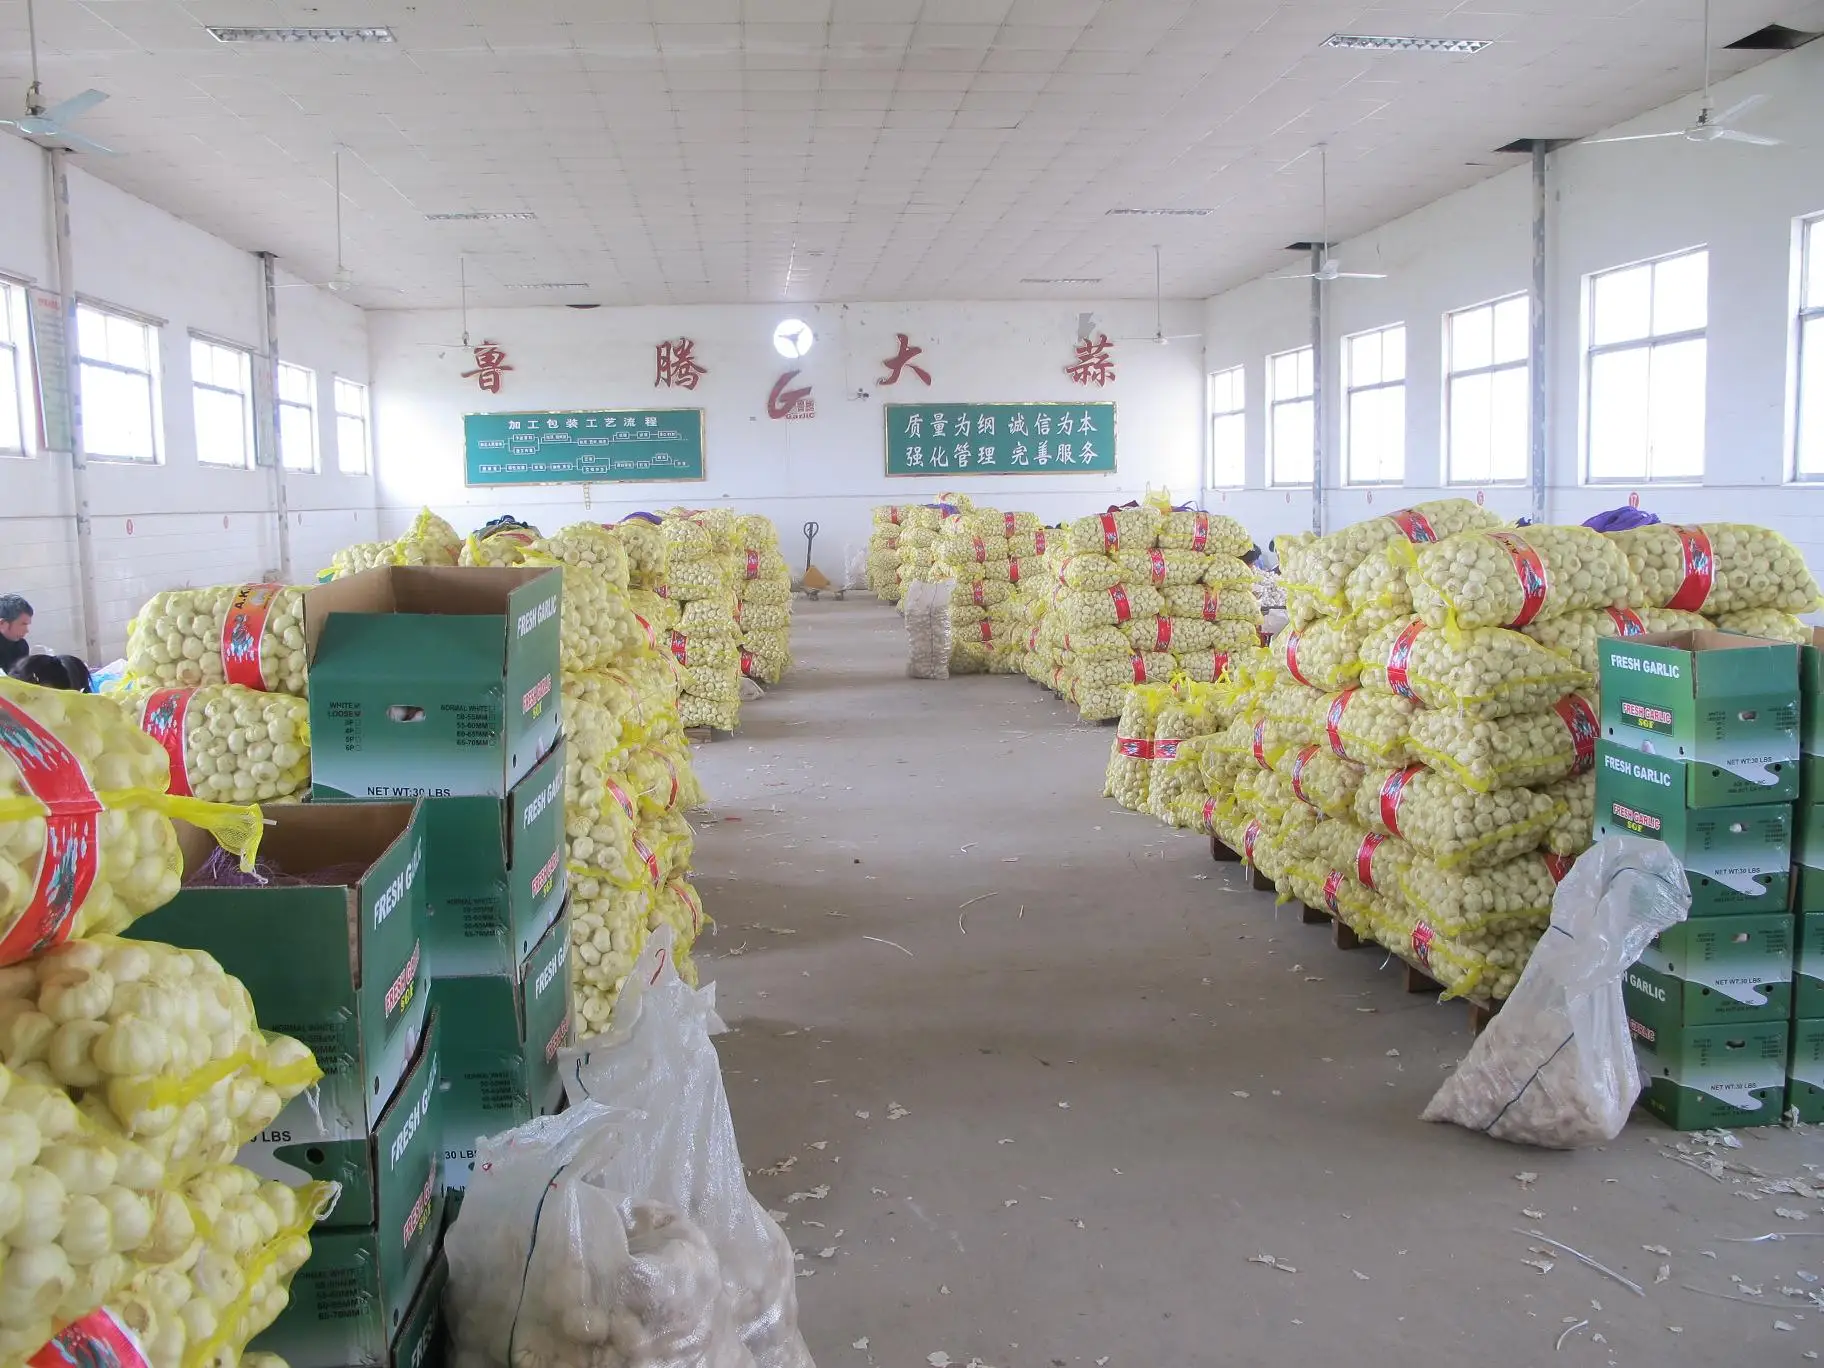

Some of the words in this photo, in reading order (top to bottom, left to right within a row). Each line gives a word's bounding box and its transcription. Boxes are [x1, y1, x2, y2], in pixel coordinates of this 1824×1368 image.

[461, 340, 513, 393] 鲁
[877, 333, 931, 386] 大
[1065, 334, 1116, 387] 蒜
[508, 417, 659, 430] 加工包装工艺流程
[905, 412, 995, 438] 质量为纲
[1008, 410, 1098, 436] 诚信为本
[905, 442, 996, 468] 强化管理
[1010, 440, 1098, 466] 完善服务
[516, 607, 537, 640] FRESH
[537, 594, 557, 625] GARLIC
[1610, 654, 1640, 671] FRESH
[1642, 660, 1680, 679] GARLIC
[1622, 702, 1645, 718] FRESH
[1645, 707, 1672, 725] GARLIC
[1604, 755, 1631, 775] FRESH
[1633, 765, 1671, 787] GARLIC
[367, 787, 389, 796] NET
[392, 787, 424, 797] WT:30
[428, 789, 450, 798] LBS
[523, 788, 546, 830] FRESH
[1613, 803, 1634, 821] FRESH
[1633, 811, 1660, 831] GARLIC
[374, 871, 404, 930] FRESH
[535, 954, 557, 999] FRESH
[1630, 974, 1666, 1002] GARLIC
[384, 967, 406, 1019] FRESH
[261, 1131, 291, 1143] LBS
[391, 1101, 420, 1172] FRESH
[445, 1150, 457, 1159] 30
